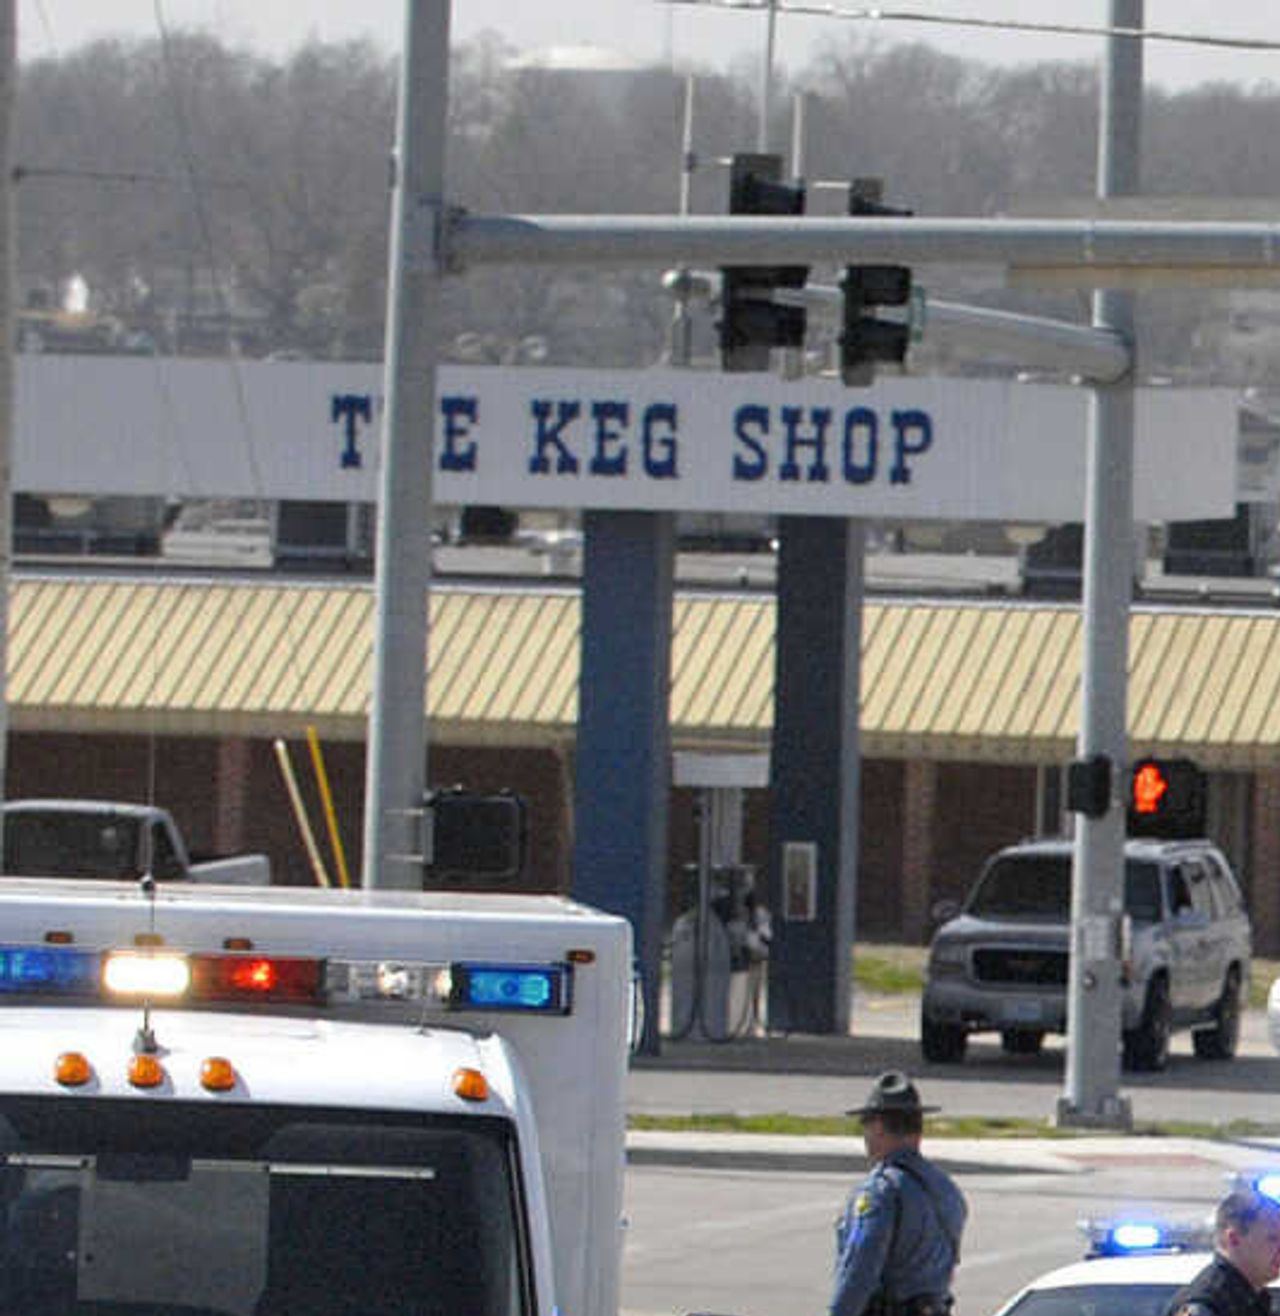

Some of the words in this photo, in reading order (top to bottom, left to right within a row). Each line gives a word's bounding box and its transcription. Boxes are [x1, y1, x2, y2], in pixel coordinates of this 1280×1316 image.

[331, 396, 478, 472] TE
[529, 400, 679, 480] KEG
[732, 404, 934, 485] SHOP
